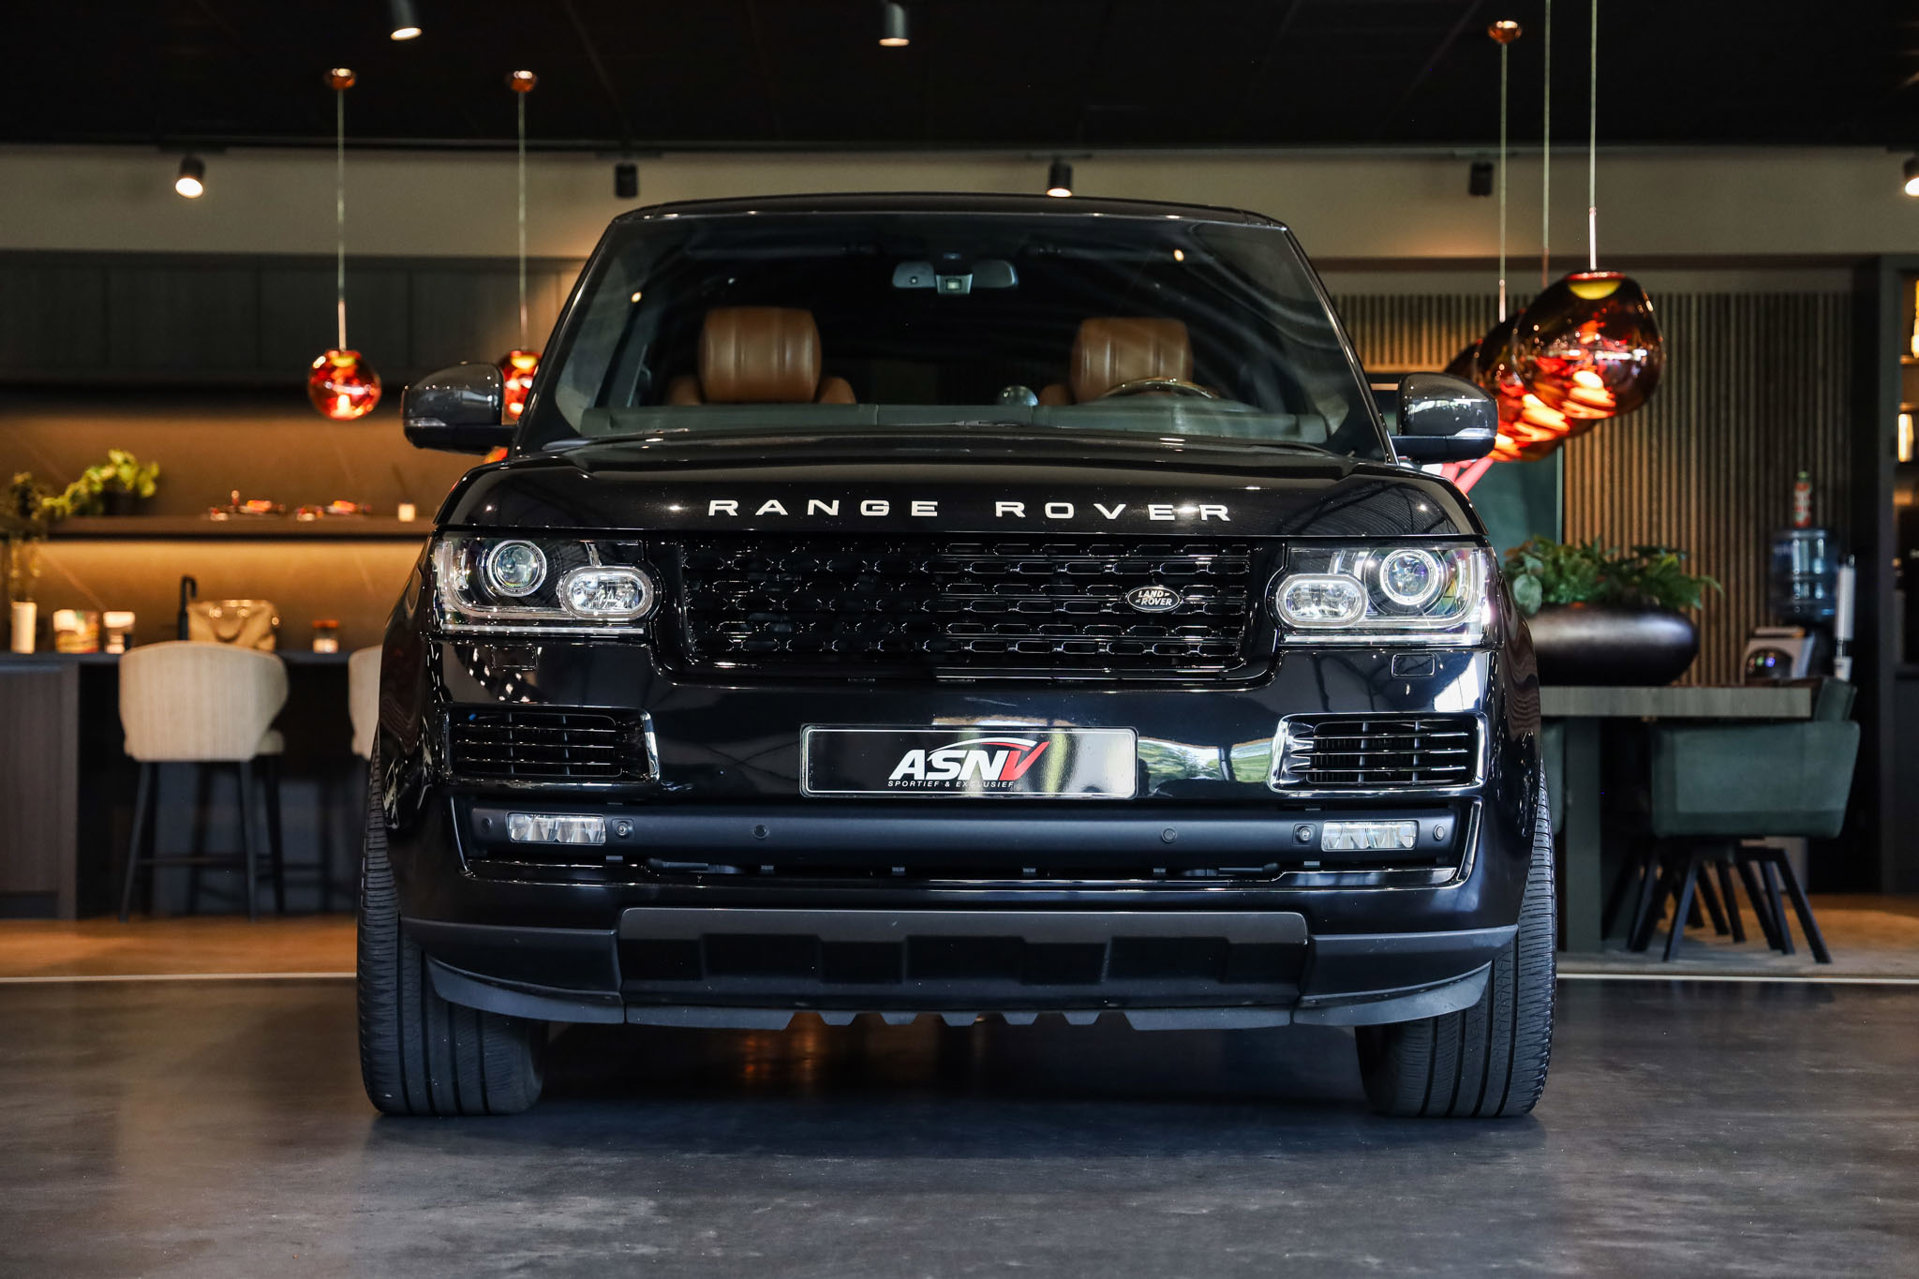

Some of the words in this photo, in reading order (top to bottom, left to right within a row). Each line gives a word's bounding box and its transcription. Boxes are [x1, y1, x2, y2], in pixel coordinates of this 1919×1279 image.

[708, 499, 938, 516] RANGE
[995, 501, 1231, 521] ROVER
[888, 740, 1050, 781] ASNV
